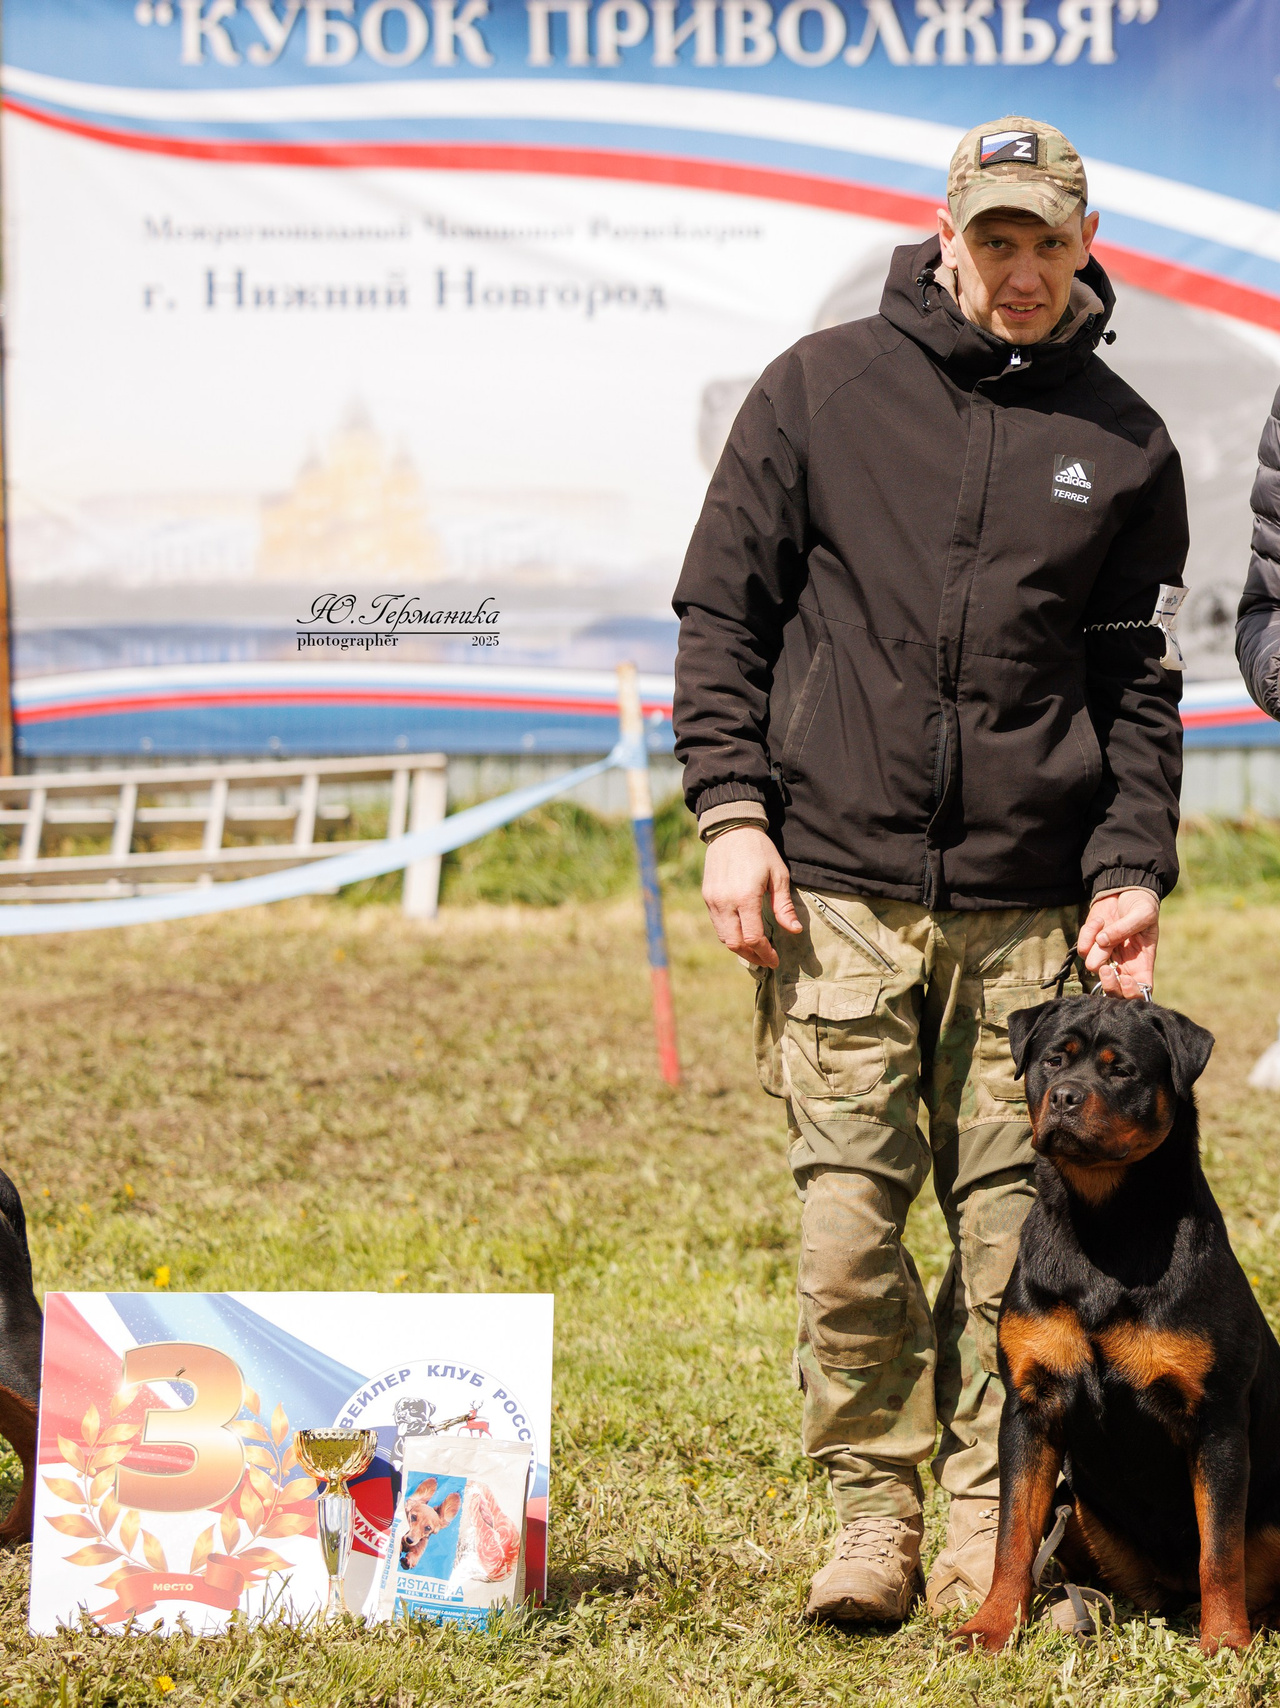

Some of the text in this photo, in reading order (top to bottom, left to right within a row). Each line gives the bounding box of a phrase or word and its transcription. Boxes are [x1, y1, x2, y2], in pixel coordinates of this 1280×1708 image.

[1013, 141, 1032, 158] Z
[203, 265, 409, 309] Нижний
[434, 265, 667, 319] Новгород
[1055, 473, 1092, 489] adidas
[1053, 488, 1090, 504] TERREX
[339, 1368, 411, 1429] ВЕЙЛЕР
[427, 1364, 485, 1387] КЛУБ
[115, 1340, 247, 1513] 3
[152, 1581, 194, 1593] место
[406, 1577, 464, 1596] STATEA
